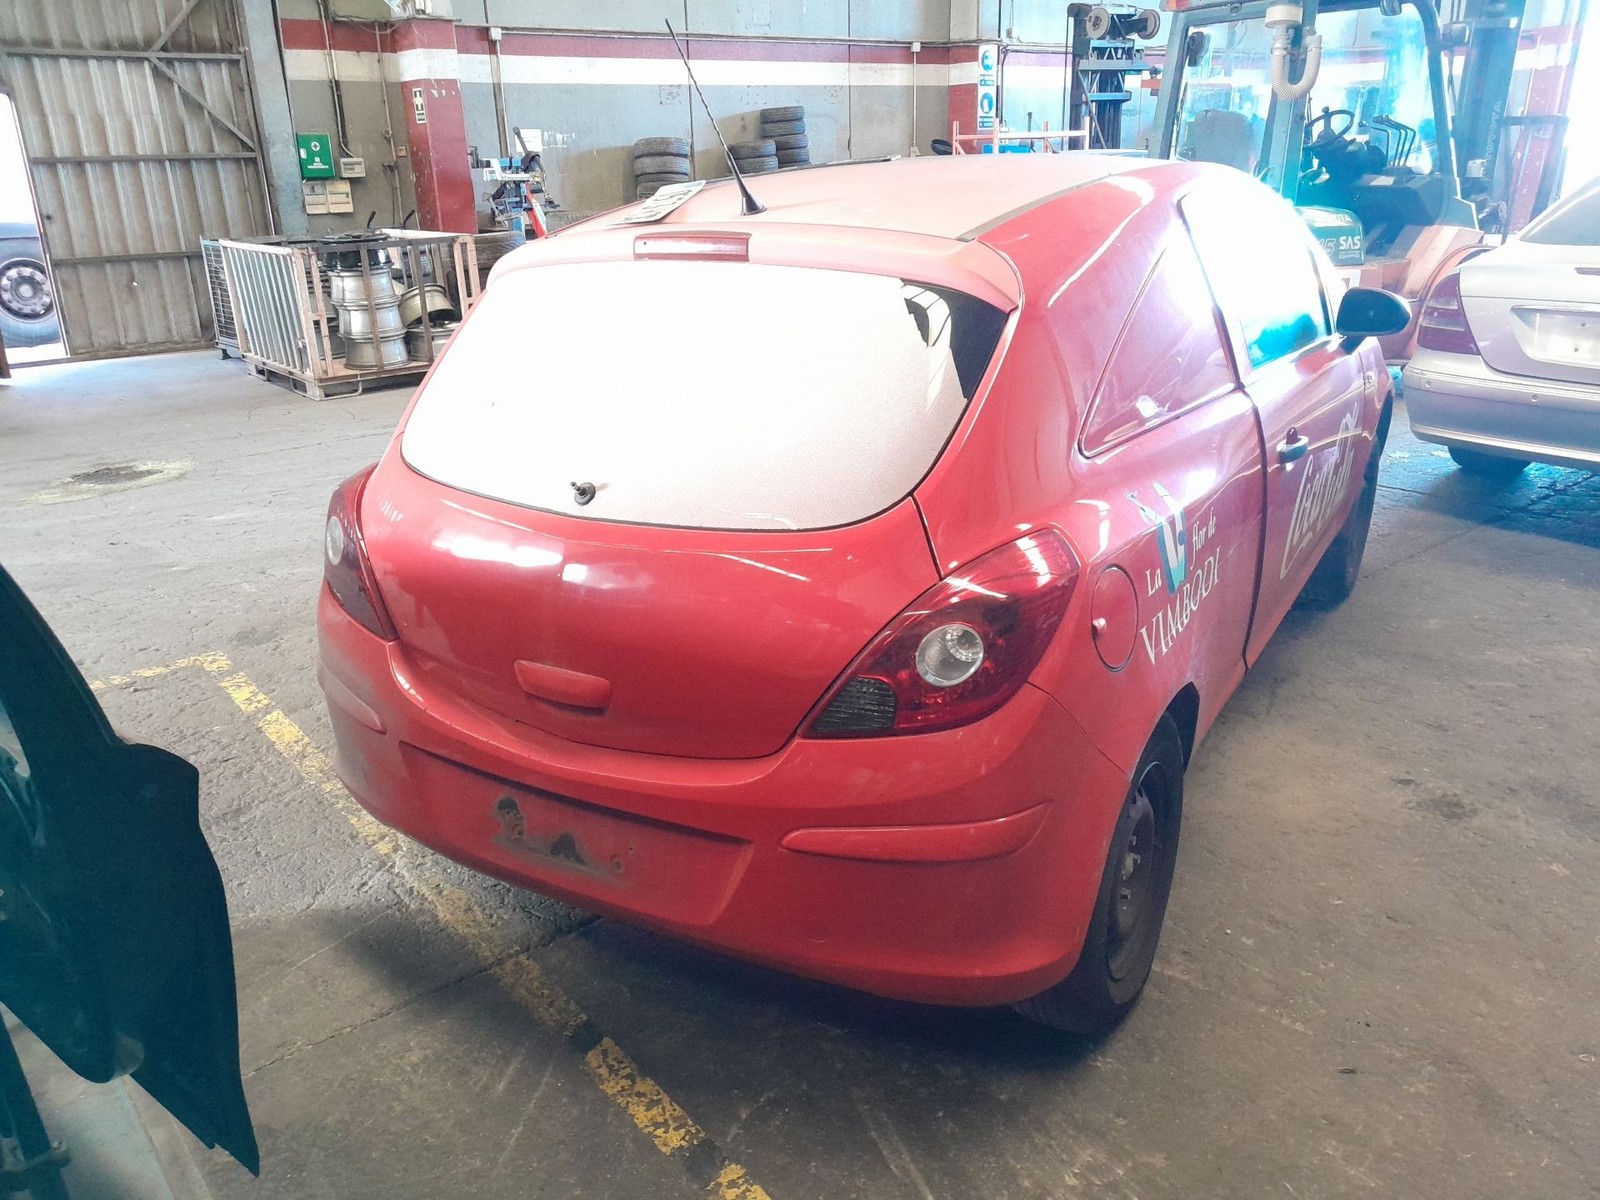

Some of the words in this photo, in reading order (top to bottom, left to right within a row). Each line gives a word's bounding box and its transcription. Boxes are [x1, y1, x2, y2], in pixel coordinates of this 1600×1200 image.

[1339, 235, 1361, 250] SAS
[1145, 568, 1162, 597] La
[1190, 520, 1207, 570] flor
[1208, 506, 1216, 539] de
[1139, 547, 1220, 666] VIMBODI
